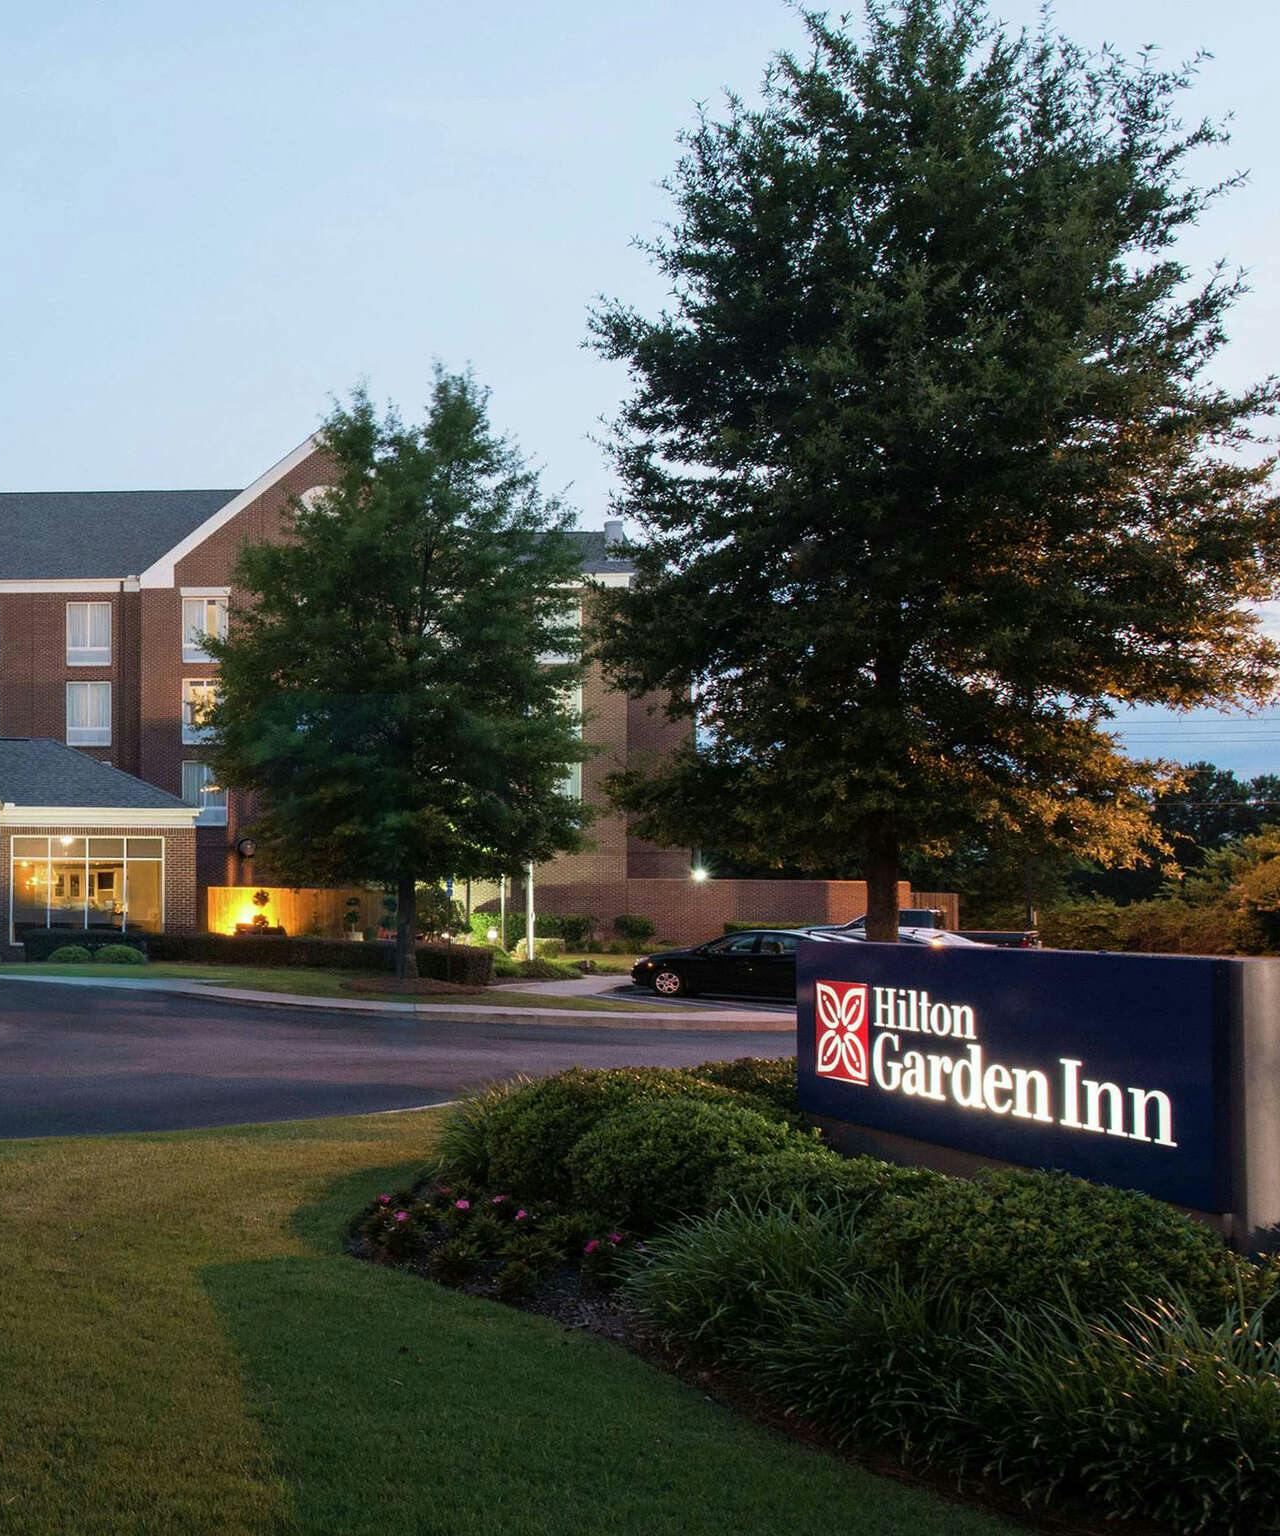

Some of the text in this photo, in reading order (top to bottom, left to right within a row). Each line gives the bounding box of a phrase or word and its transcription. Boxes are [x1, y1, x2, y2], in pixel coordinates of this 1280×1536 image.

[873, 987, 977, 1040] Hilton
[873, 1032, 1178, 1148] Garden Inn
